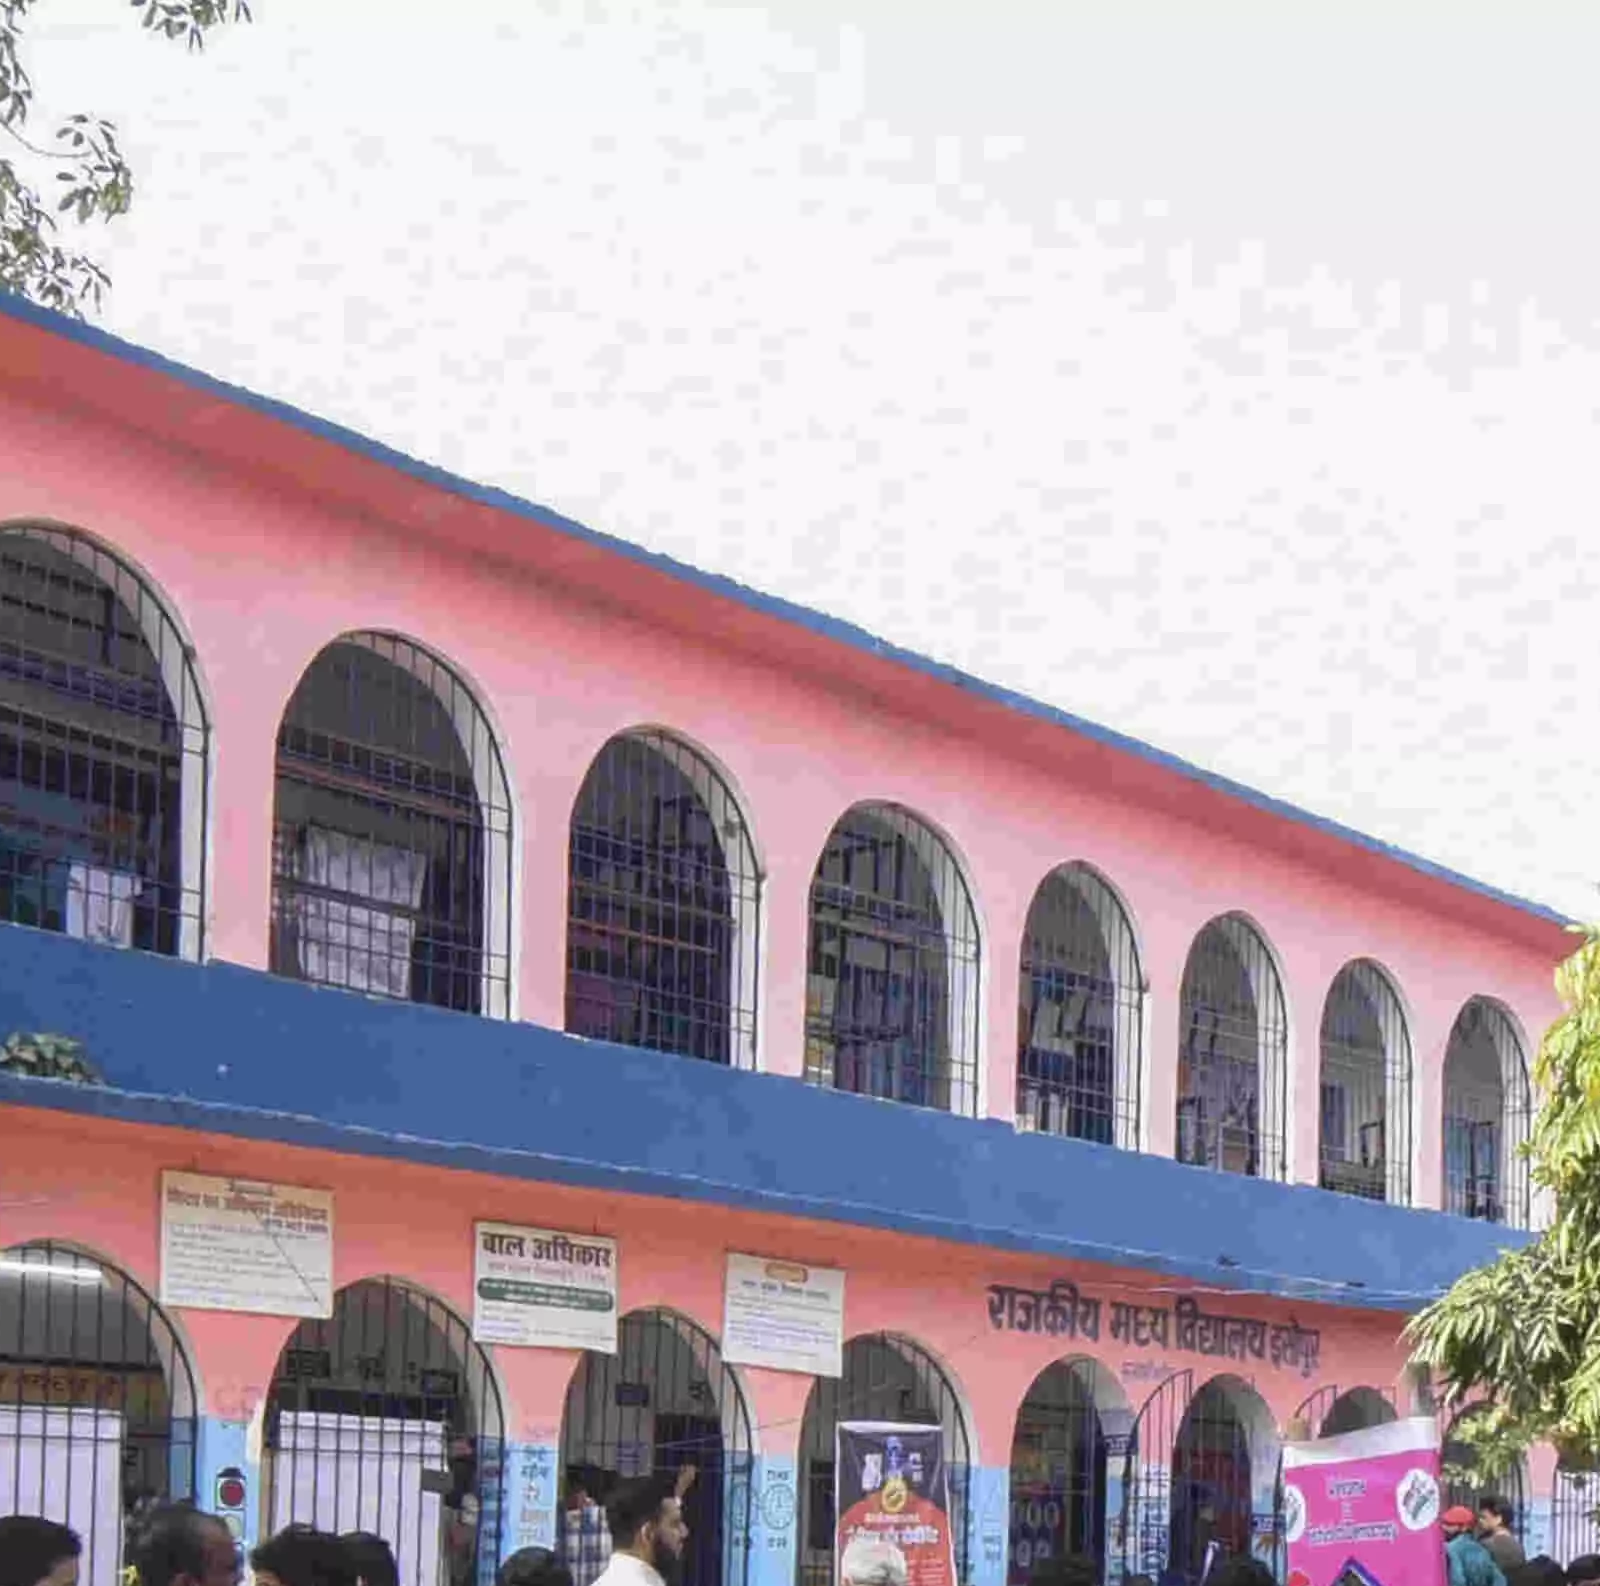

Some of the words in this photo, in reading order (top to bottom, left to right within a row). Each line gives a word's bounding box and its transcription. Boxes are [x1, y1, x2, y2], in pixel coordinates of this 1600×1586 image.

[479, 1231, 526, 1258] बाल
[532, 1234, 612, 1267] अधिकार
[986, 1278, 1101, 1343] राजकीय
[1174, 1296, 1267, 1362] विद्यालय
